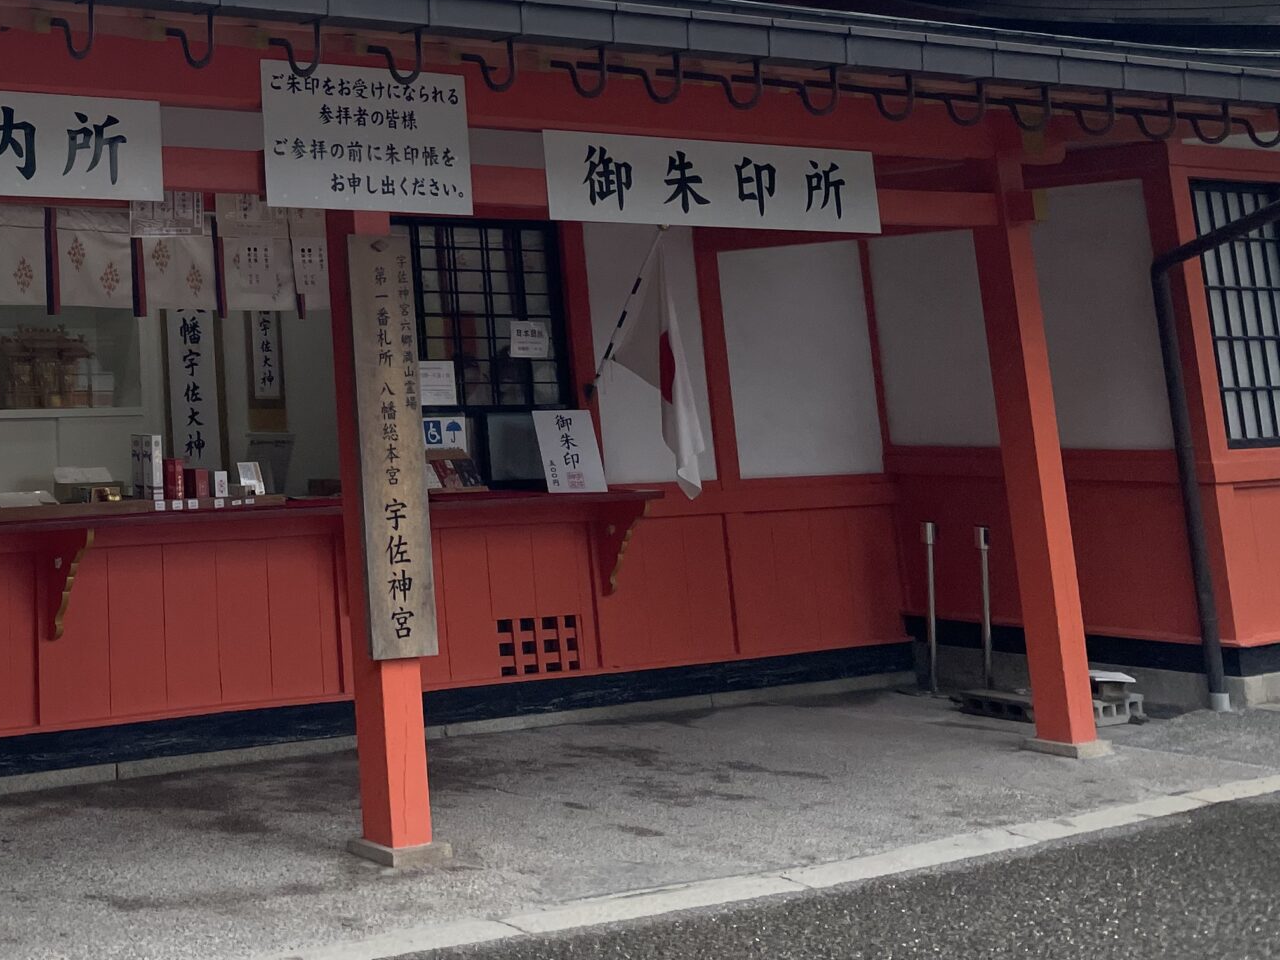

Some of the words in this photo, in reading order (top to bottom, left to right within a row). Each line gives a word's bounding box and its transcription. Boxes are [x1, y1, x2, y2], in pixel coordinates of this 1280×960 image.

[270, 73, 459, 105] ご朱印をお受けになられる
[318, 104, 418, 130] 参拝者の皆様
[273, 137, 456, 167] ご参拝の前に朱印帳を
[330, 173, 465, 199] お申し出ください。
[583, 144, 846, 220] 御朱印所
[259, 311, 274, 387] 宇佐大神
[375, 266, 392, 368] 第一番札所
[176, 309, 206, 460] 幡宇佐大神
[380, 381, 400, 486] 八幡総本宮
[555, 414, 580, 470] 御朱印
[384, 498, 415, 640] 宇佐神宮
